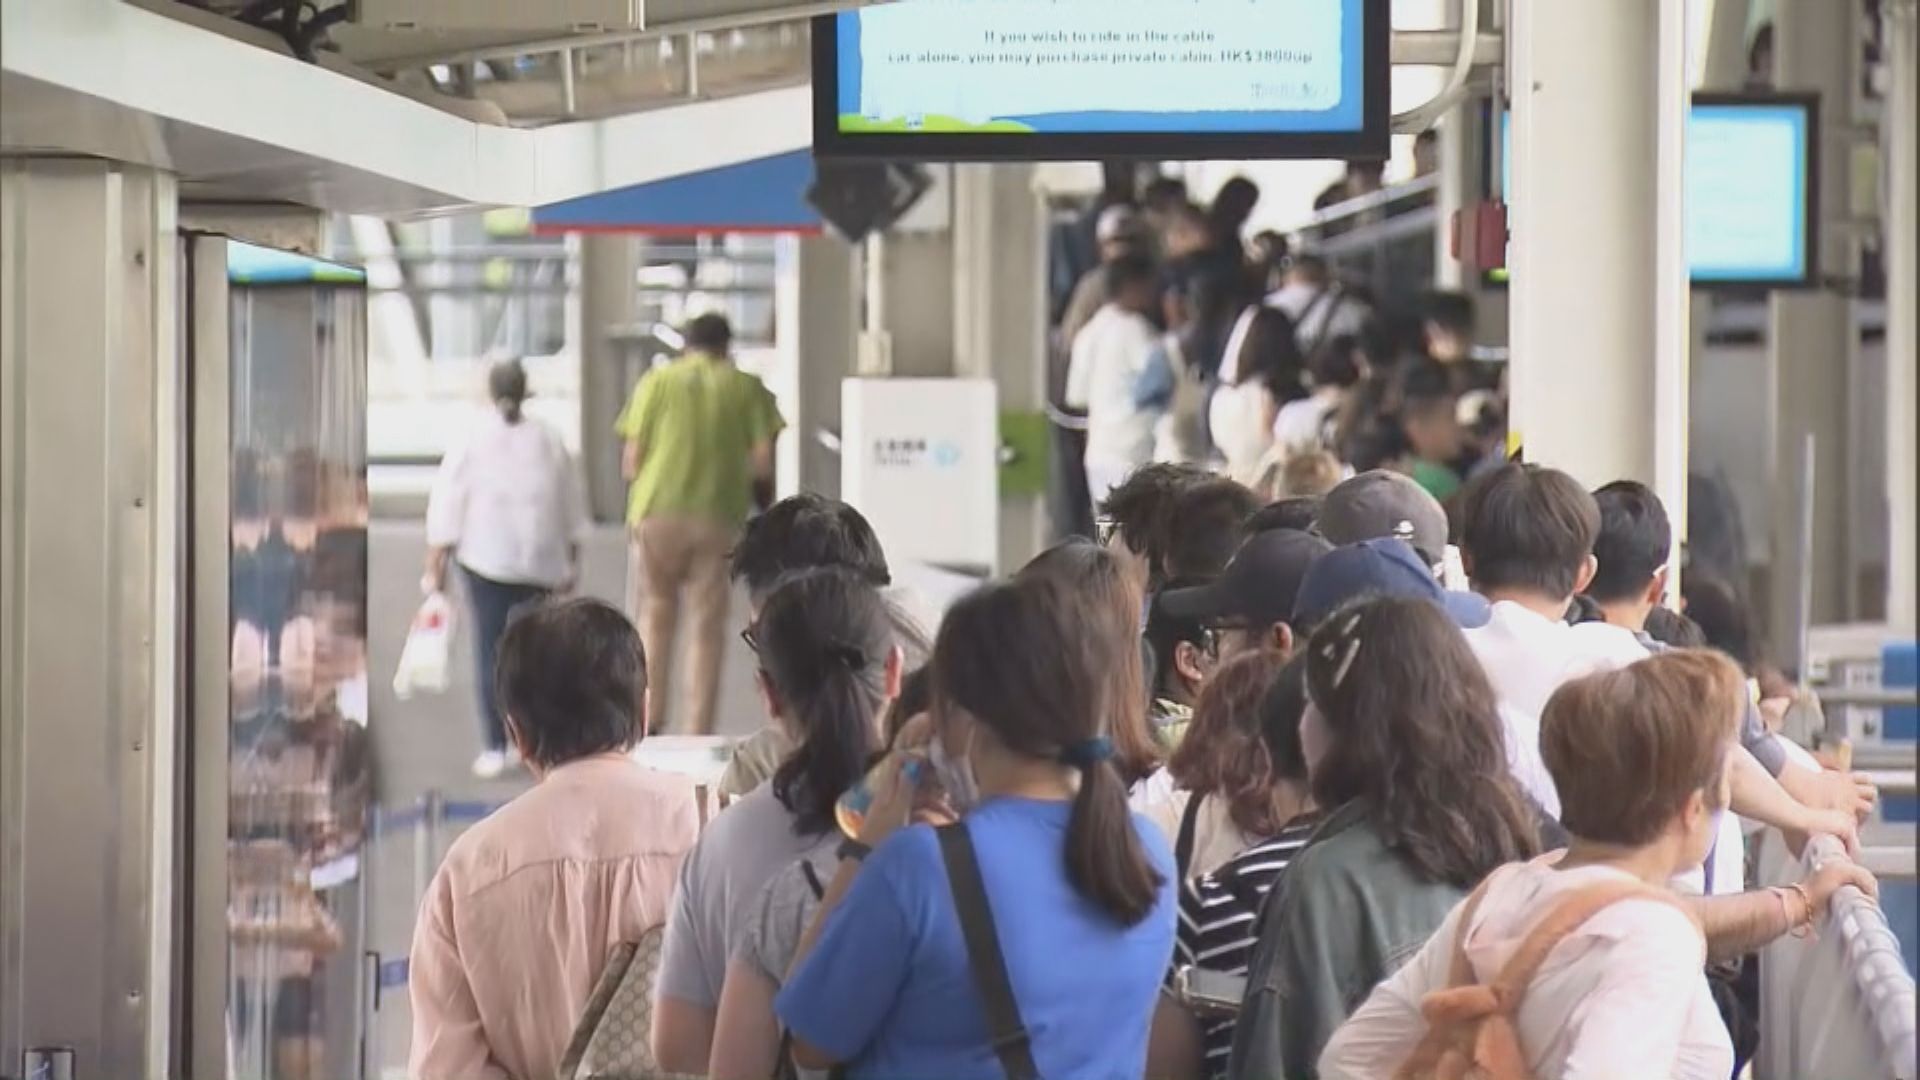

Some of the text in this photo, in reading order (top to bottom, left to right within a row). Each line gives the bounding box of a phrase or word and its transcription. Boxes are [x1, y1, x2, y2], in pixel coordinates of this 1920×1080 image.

[985, 30, 1215, 44] If you wish to ride in the cable
[888, 53, 911, 63] car
[968, 53, 995, 65] you
[999, 53, 1033, 65] may
[1036, 50, 1109, 65] purchase
[1112, 50, 1167, 64] private
